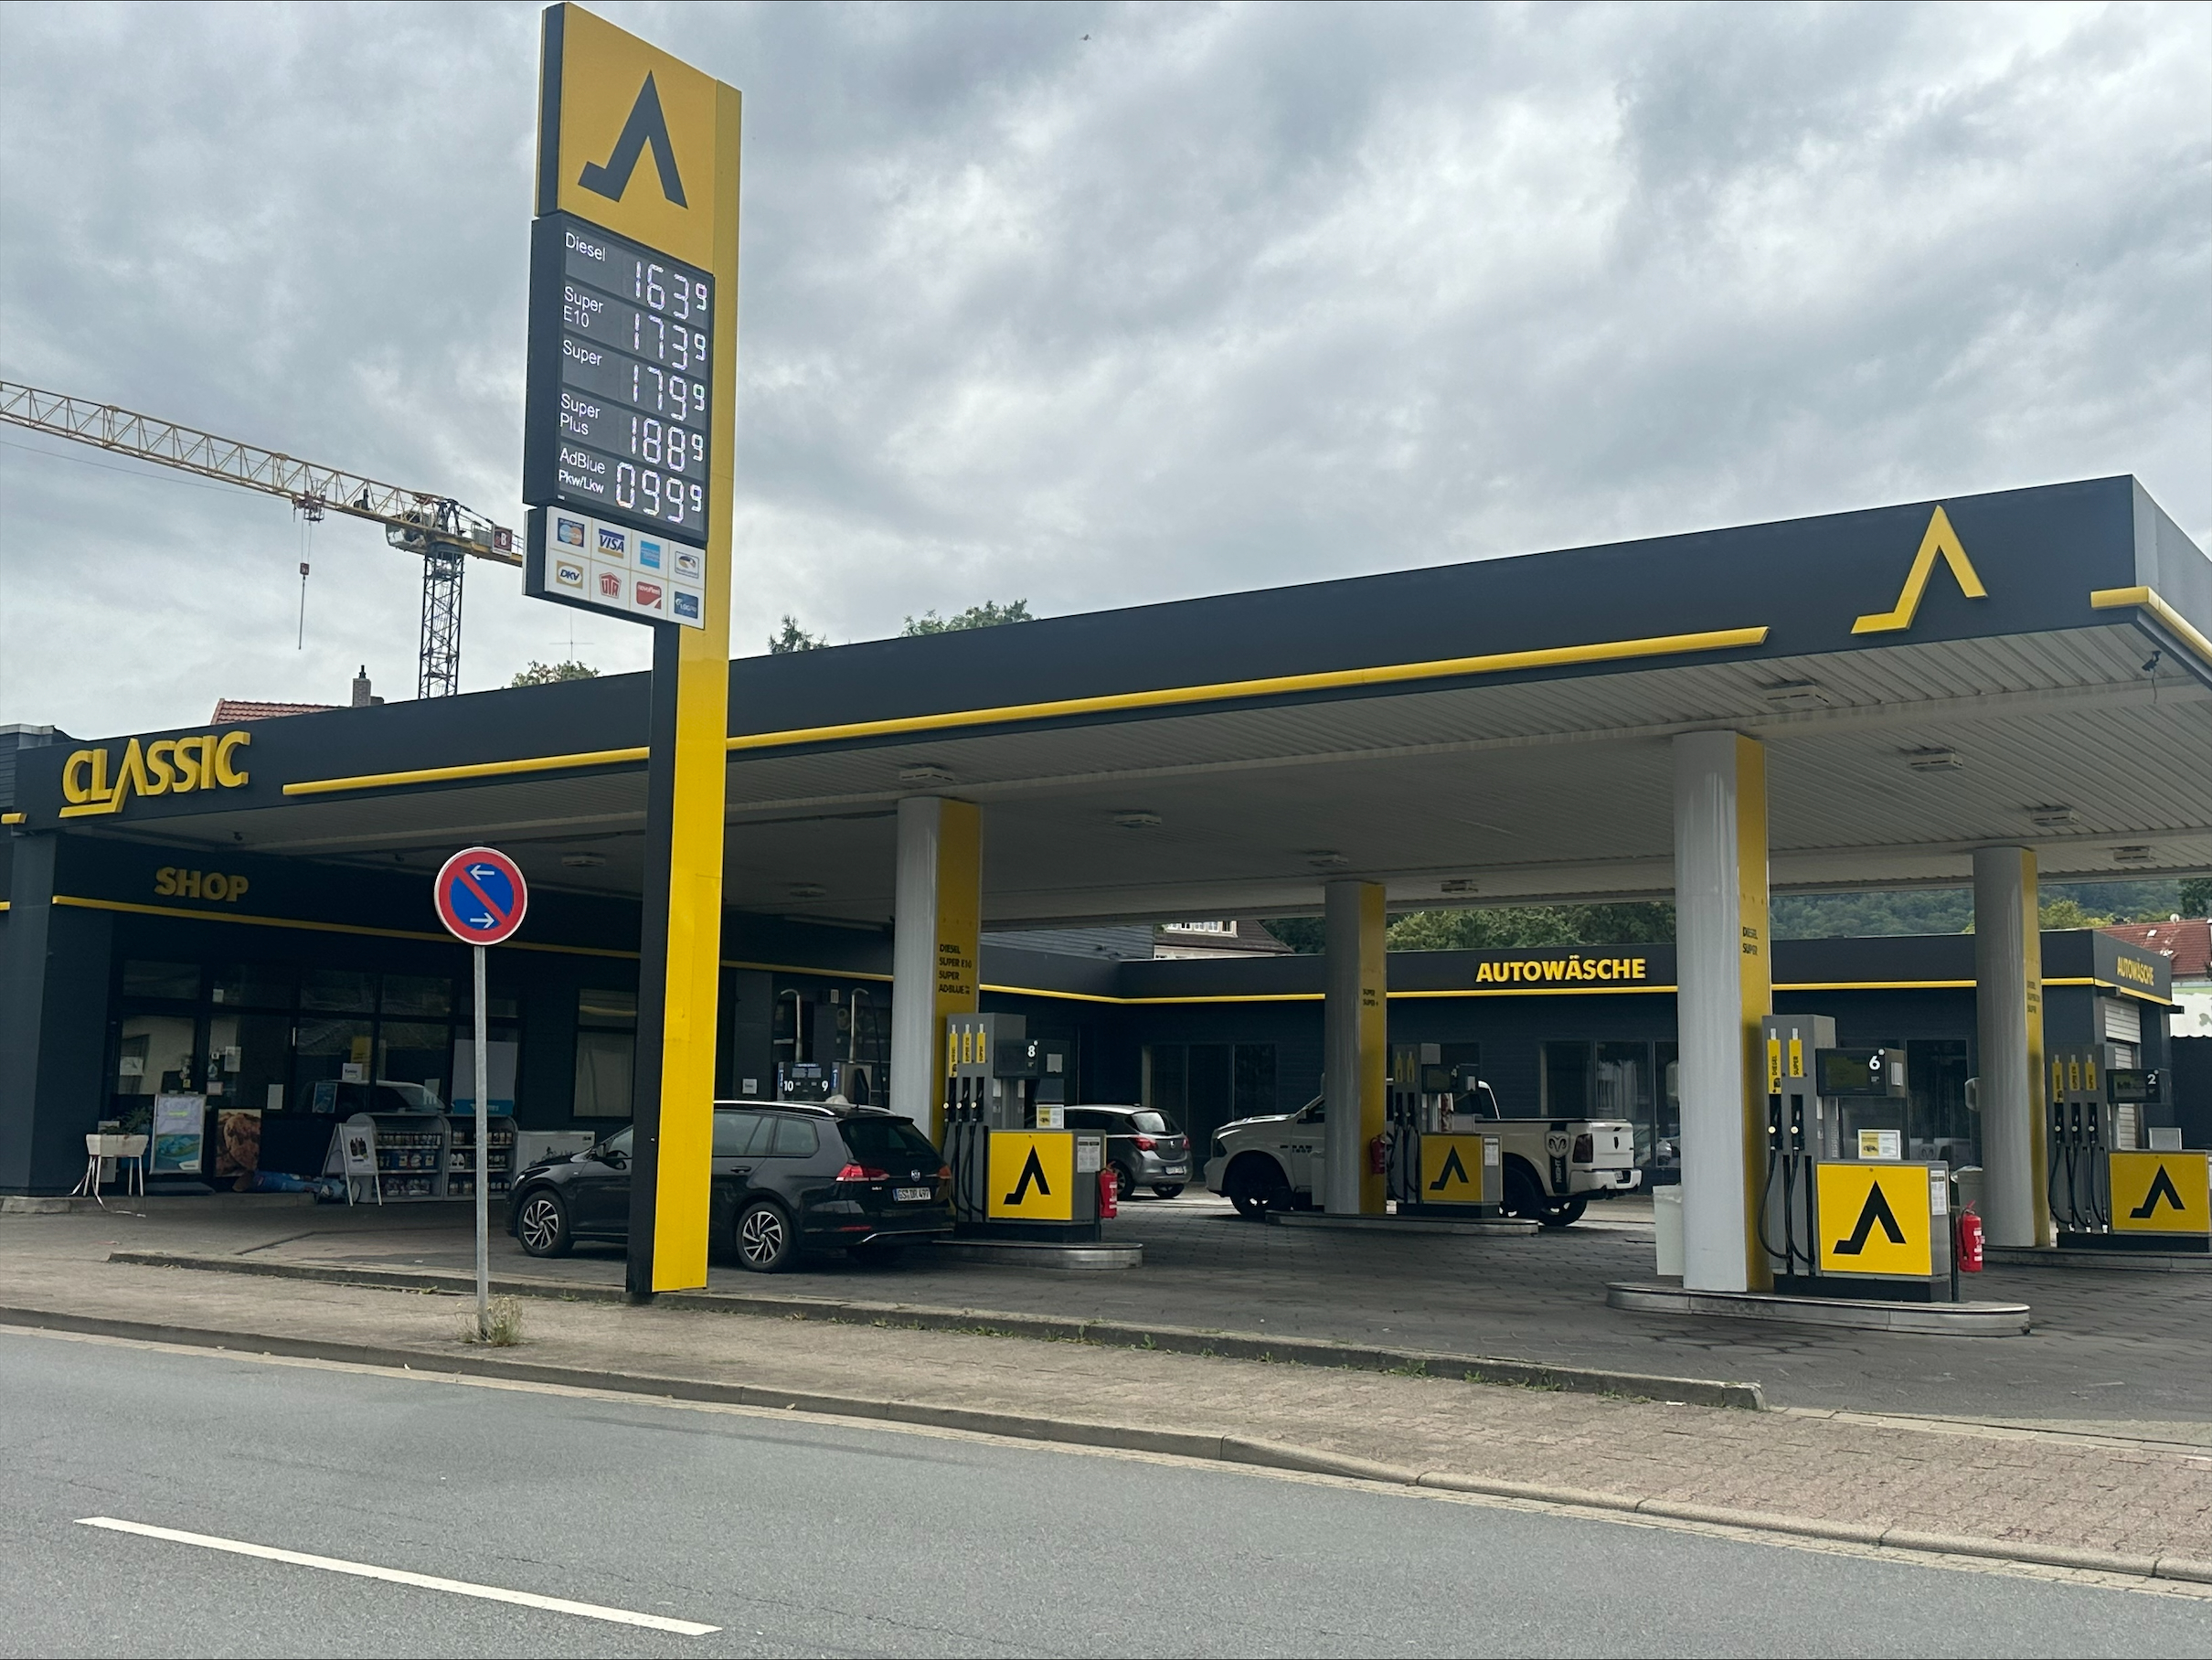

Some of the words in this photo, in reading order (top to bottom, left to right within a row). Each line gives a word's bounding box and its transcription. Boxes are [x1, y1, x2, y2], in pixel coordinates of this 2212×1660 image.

[565, 231, 606, 261] Diesel
[564, 286, 603, 314] Super
[563, 305, 590, 327] E10
[562, 339, 603, 366] Super
[560, 393, 601, 419] Super
[559, 412, 590, 435] Plus
[559, 447, 606, 474] AdBlue
[558, 469, 604, 495] Pkw/Lkw
[600, 535, 624, 553] VISA
[560, 569, 580, 580] DKV
[601, 576, 620, 597] UTA
[58, 730, 251, 818] CLASSIC
[154, 867, 250, 902] SHOP
[939, 943, 961, 954] DIESEL
[939, 956, 960, 967] SUPER
[961, 959, 973, 969] E10
[1475, 954, 1646, 983] AUTOWÄSCHE
[939, 970, 960, 981] SUPER
[1027, 1045, 1036, 1058] 8
[1868, 1055, 1881, 1070] 6
[1451, 1069, 1458, 1078] 4
[2147, 1073, 2157, 1085] 2
[783, 1080, 794, 1091] 10
[822, 1080, 829, 1091] 9
